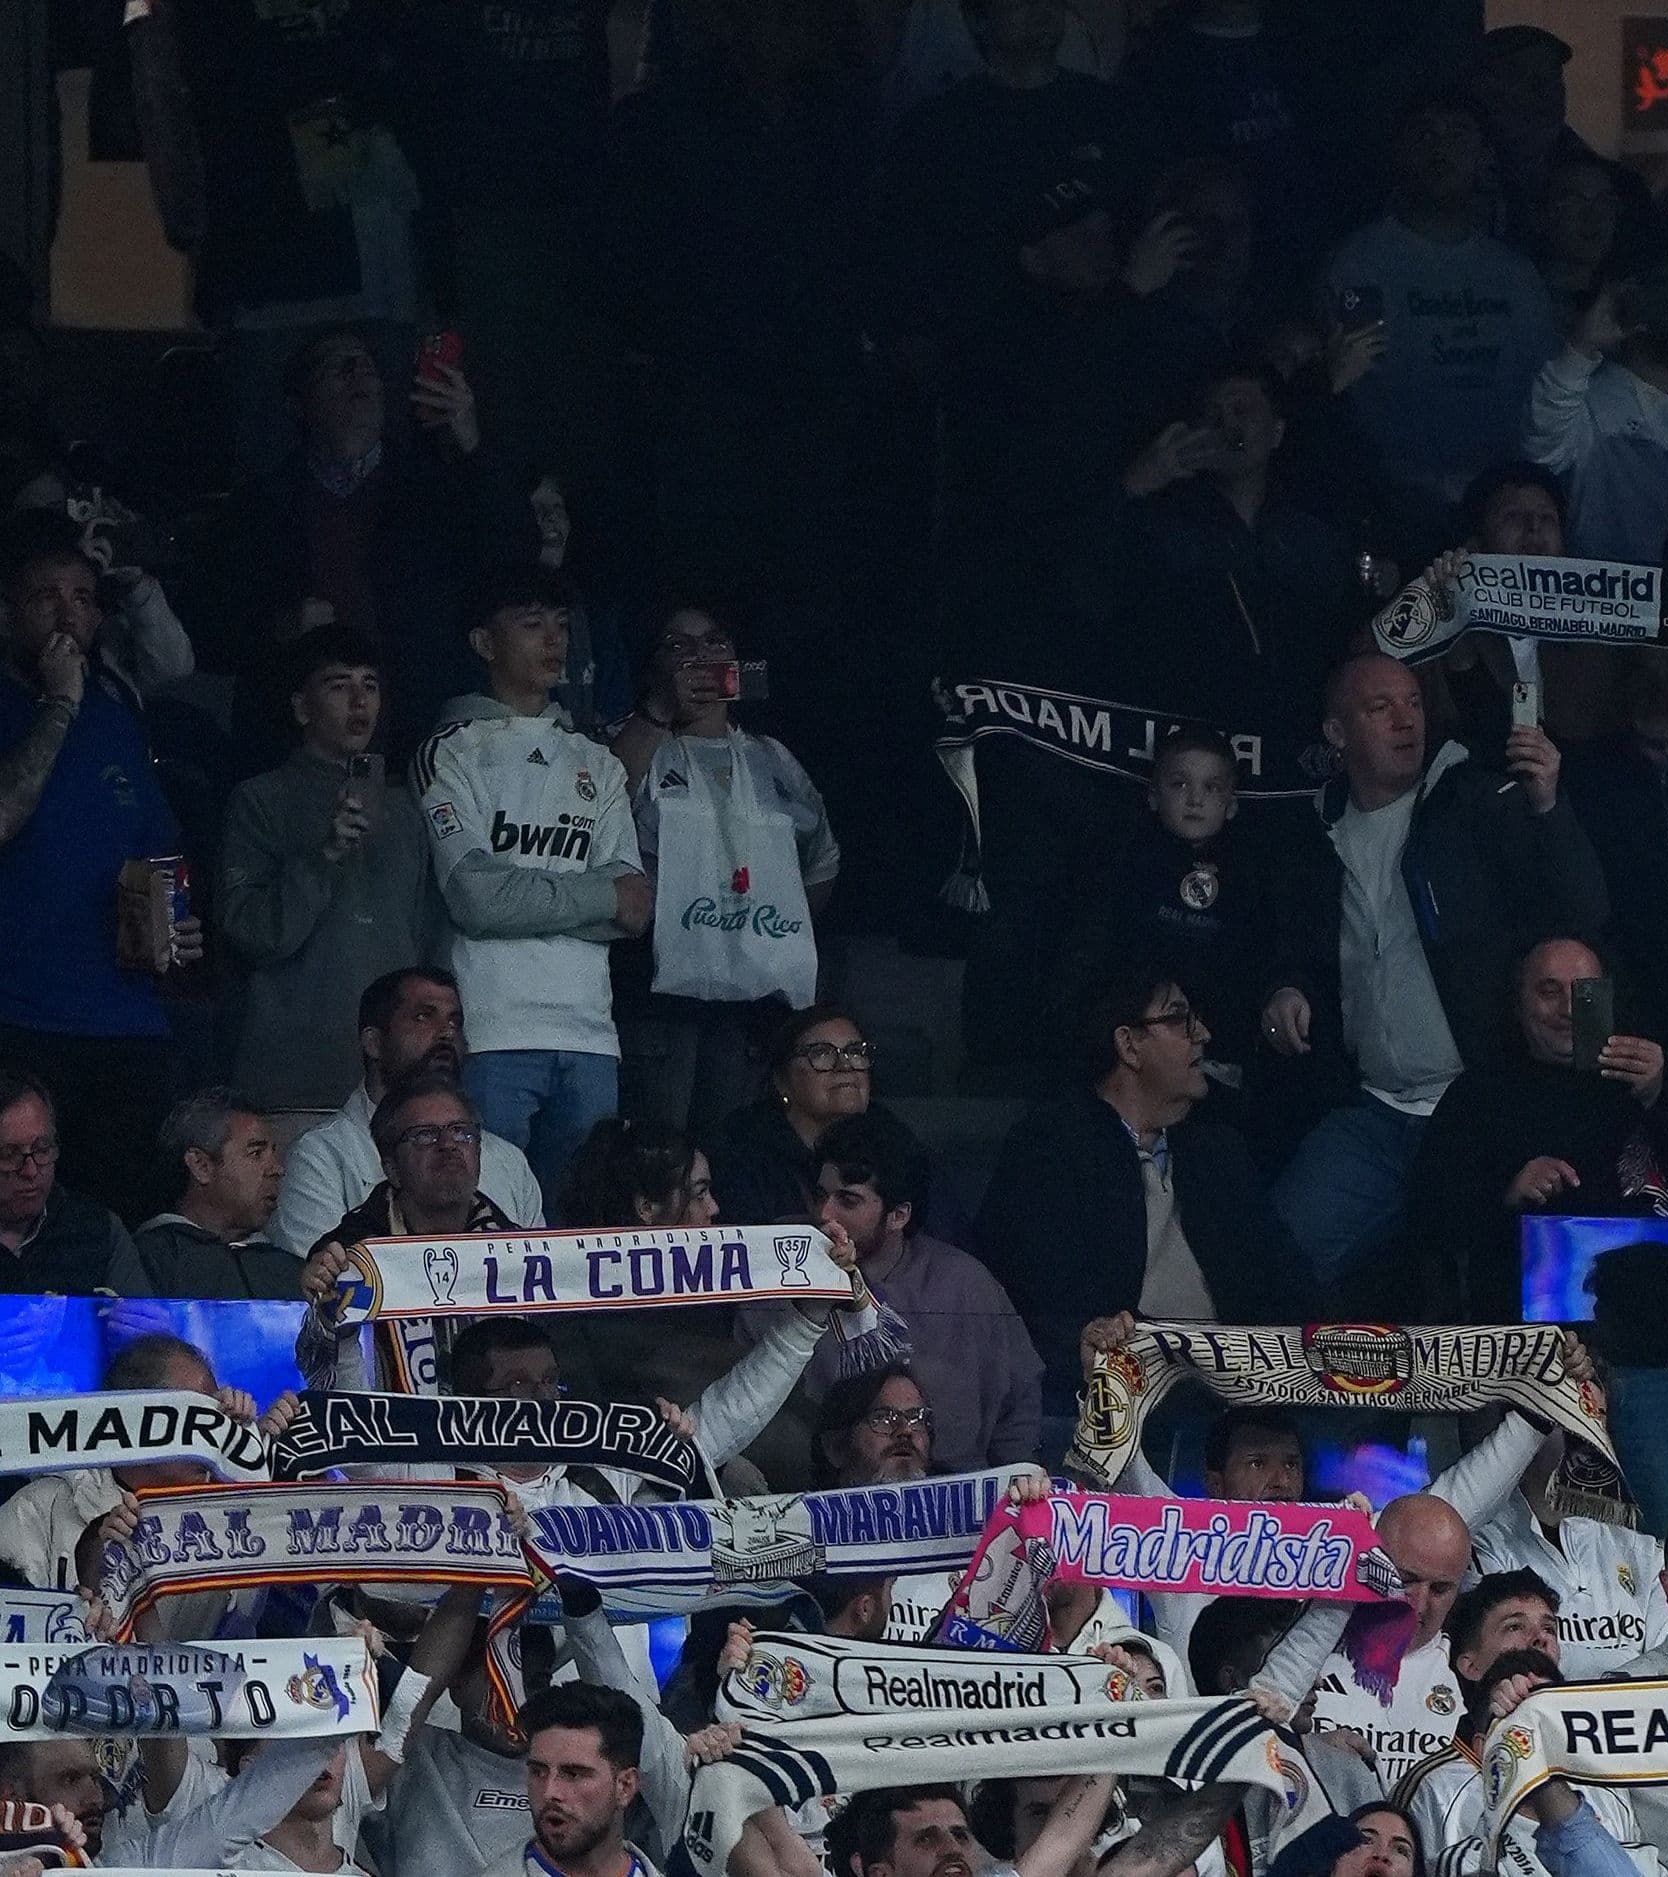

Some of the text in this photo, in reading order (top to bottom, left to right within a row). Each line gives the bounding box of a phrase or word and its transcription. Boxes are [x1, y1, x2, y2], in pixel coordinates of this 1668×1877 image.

[1456, 560, 1653, 602] Realmadrid
[1474, 588, 1640, 619] CLUB DE FUTBOL
[491, 811, 591, 861] bwin
[681, 896, 802, 938] Puerto Rico
[488, 1228, 746, 1254] PEÑA MADRIDISTA
[783, 1237, 799, 1253] 35
[434, 1271, 451, 1286] 14
[482, 1242, 754, 1304] LA COMA
[1152, 1325, 1566, 1386] REAL MADRID
[1234, 1376, 1483, 1408] ESTADIO SANTIAGO BERNABEU
[28, 1405, 265, 1472] MADRID
[437, 1399, 697, 1485] MADRID
[286, 1504, 522, 1560] MADRI
[530, 1502, 713, 1557] JUANITO
[806, 1476, 1003, 1547] MARAVILL
[1050, 1496, 1352, 1592] Madridista
[29, 1651, 246, 1677] PEÑA MADRIDISTA
[867, 1665, 1047, 1708] Realmadrid
[863, 1716, 1138, 1753] Realmadrid
